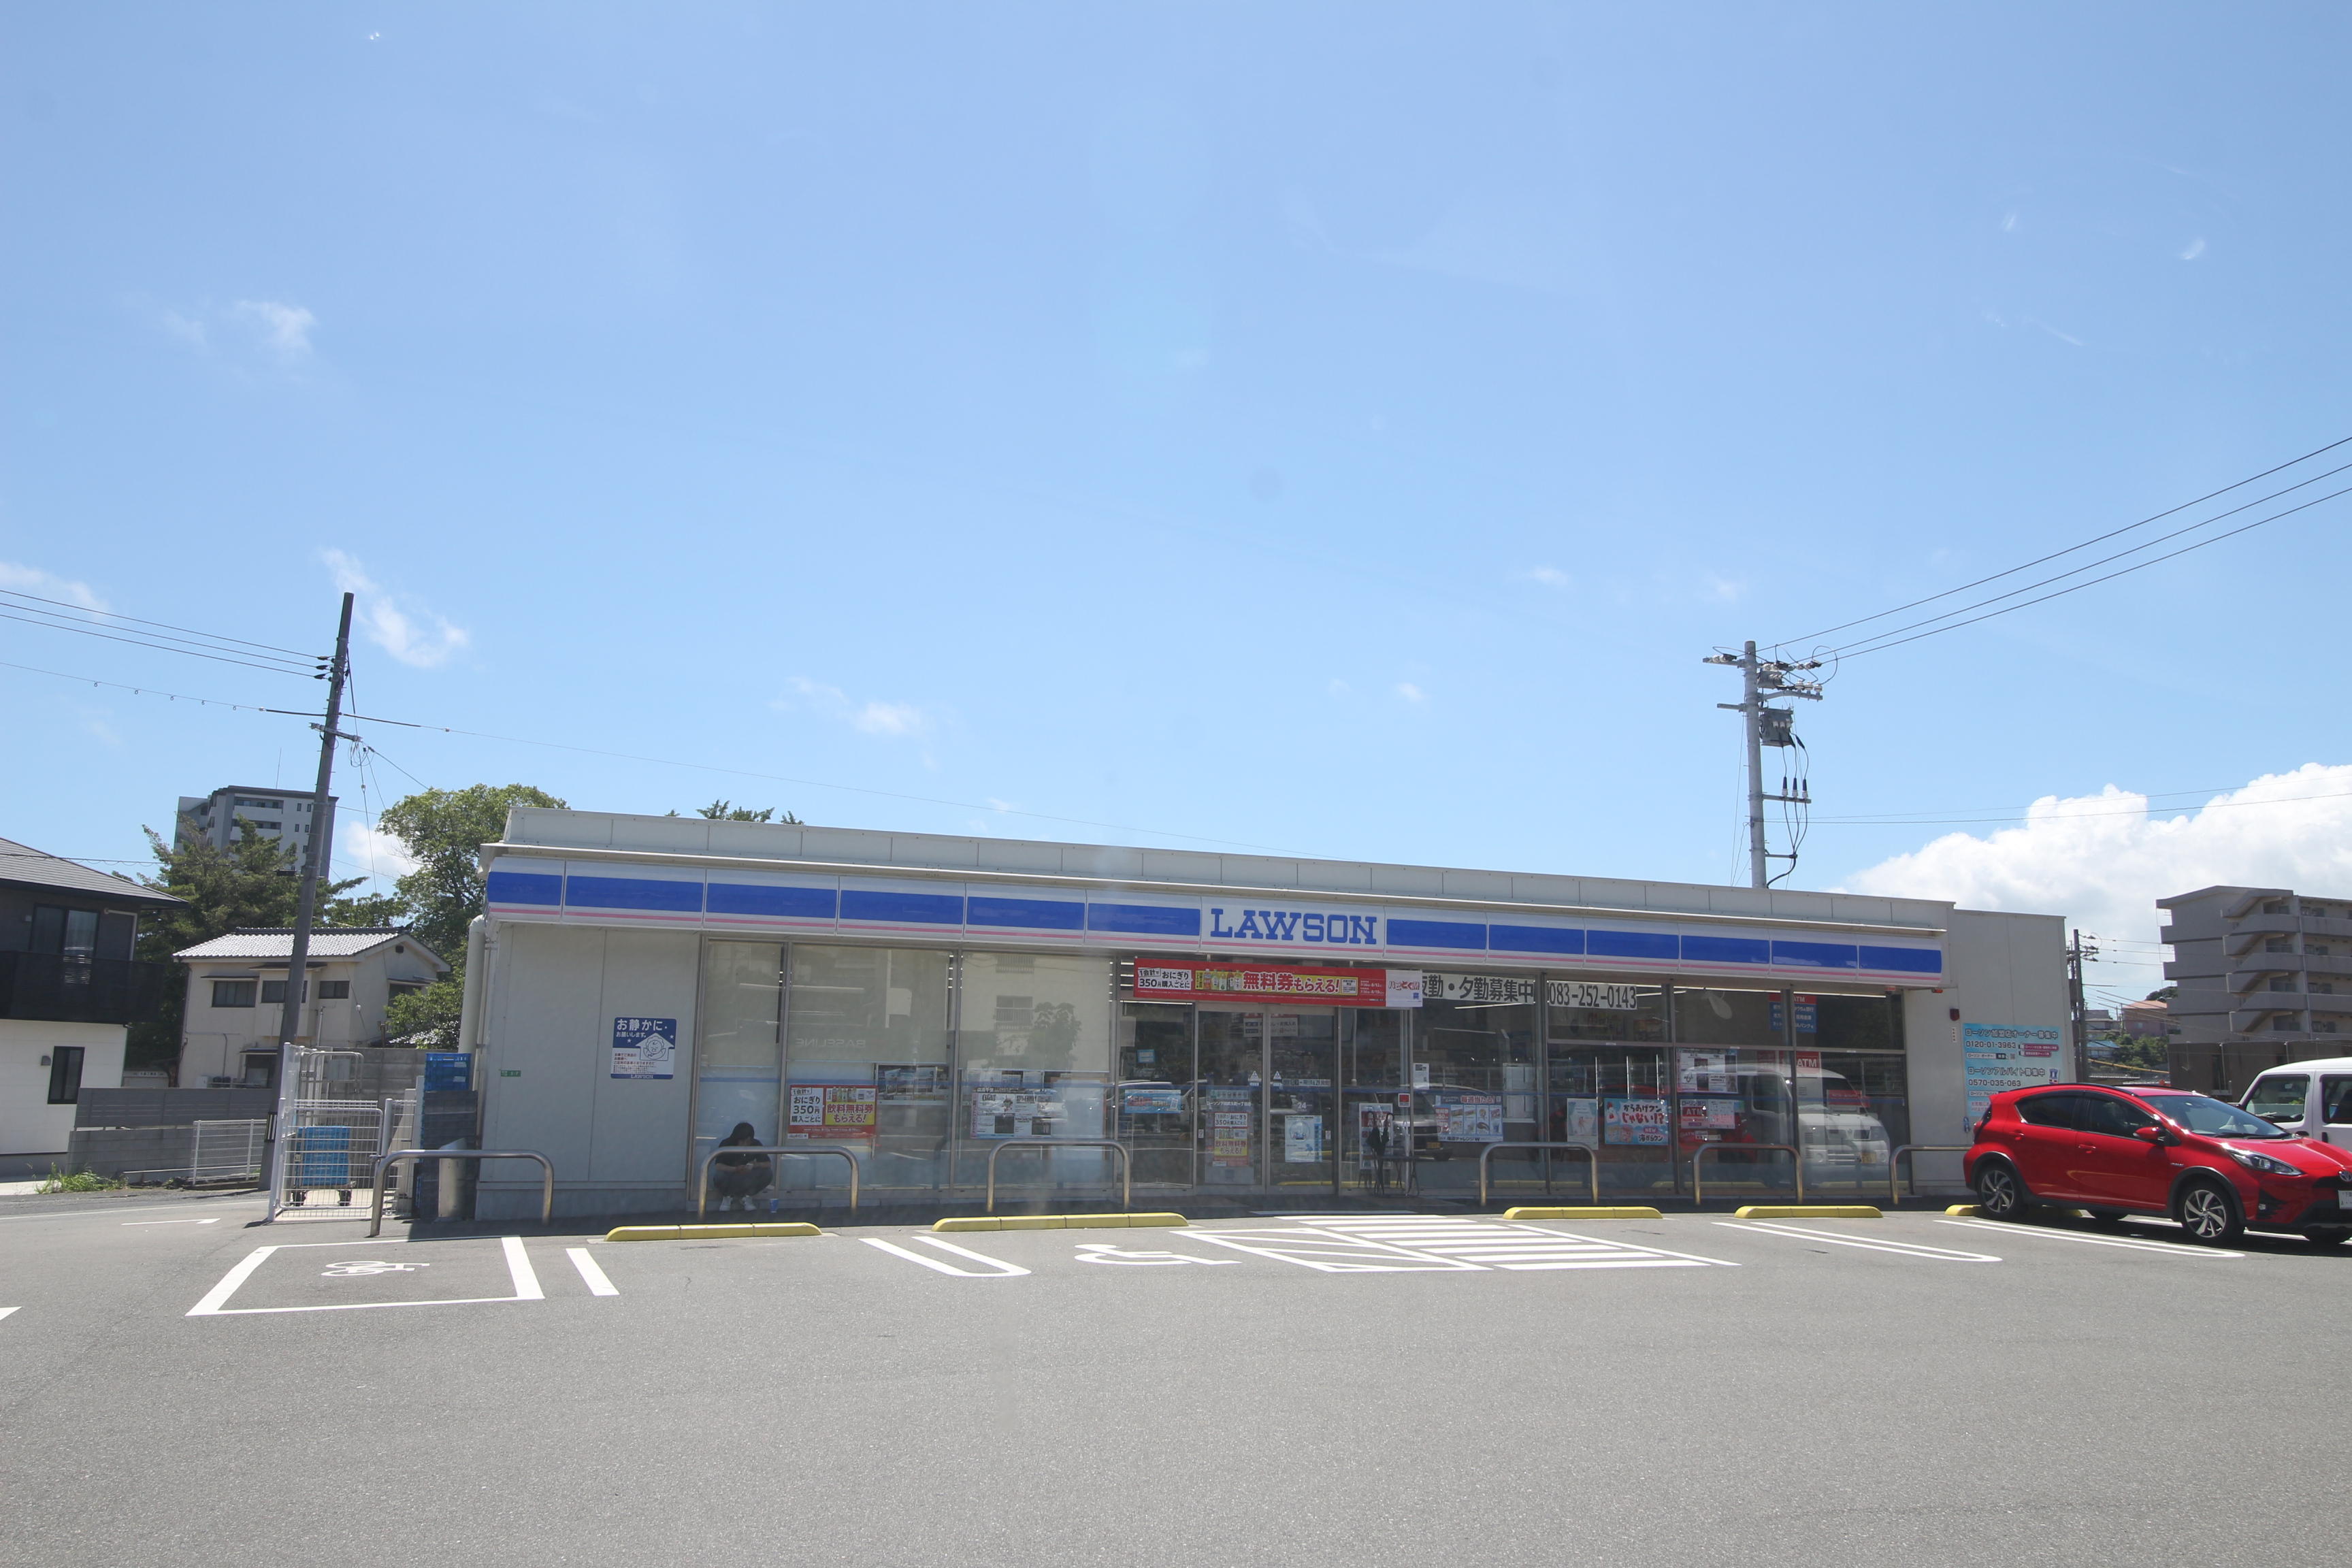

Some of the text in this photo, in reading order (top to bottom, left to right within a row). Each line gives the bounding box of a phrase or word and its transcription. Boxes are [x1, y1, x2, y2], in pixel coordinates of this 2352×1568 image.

[1210, 908, 1377, 945] LAWSON
[1162, 971, 1189, 979] おにぎり
[1549, 983, 1636, 1009] 083-252-0143
[617, 1019, 663, 1030] お静かに
[1965, 1028, 2058, 1039] ローソン加盟店オーナー募集中
[1796, 1058, 1817, 1067] ATM
[1968, 1067, 2045, 1077] ローソンアルバイト募集中
[827, 1104, 873, 1113] 飲料無料券
[1623, 1104, 1662, 1113] からあげクン
[834, 1114, 866, 1123] もらえる!
